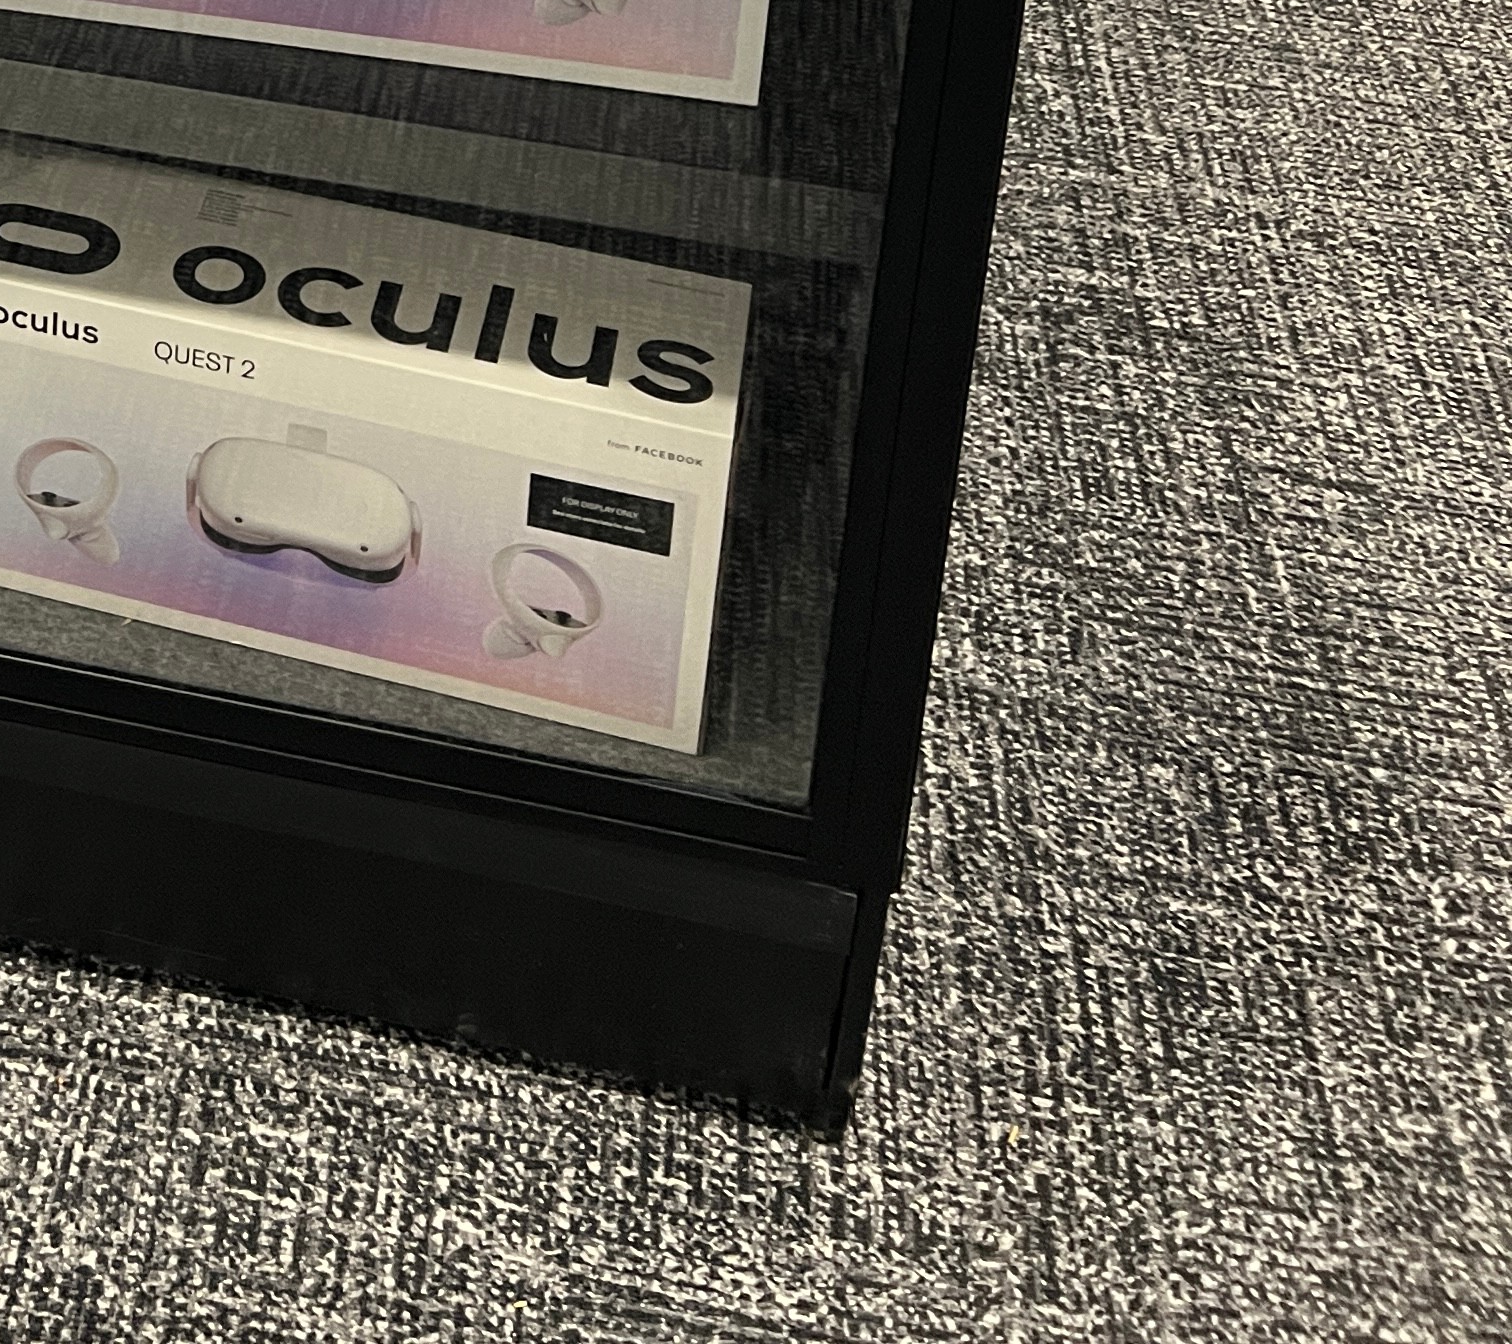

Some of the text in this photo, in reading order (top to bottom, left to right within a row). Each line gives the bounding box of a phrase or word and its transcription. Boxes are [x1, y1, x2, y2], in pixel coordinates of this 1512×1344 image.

[171, 244, 716, 405] oculus
[154, 341, 235, 374] QUEST
[241, 359, 256, 379] 2
[635, 445, 704, 467] FACEBOOK
